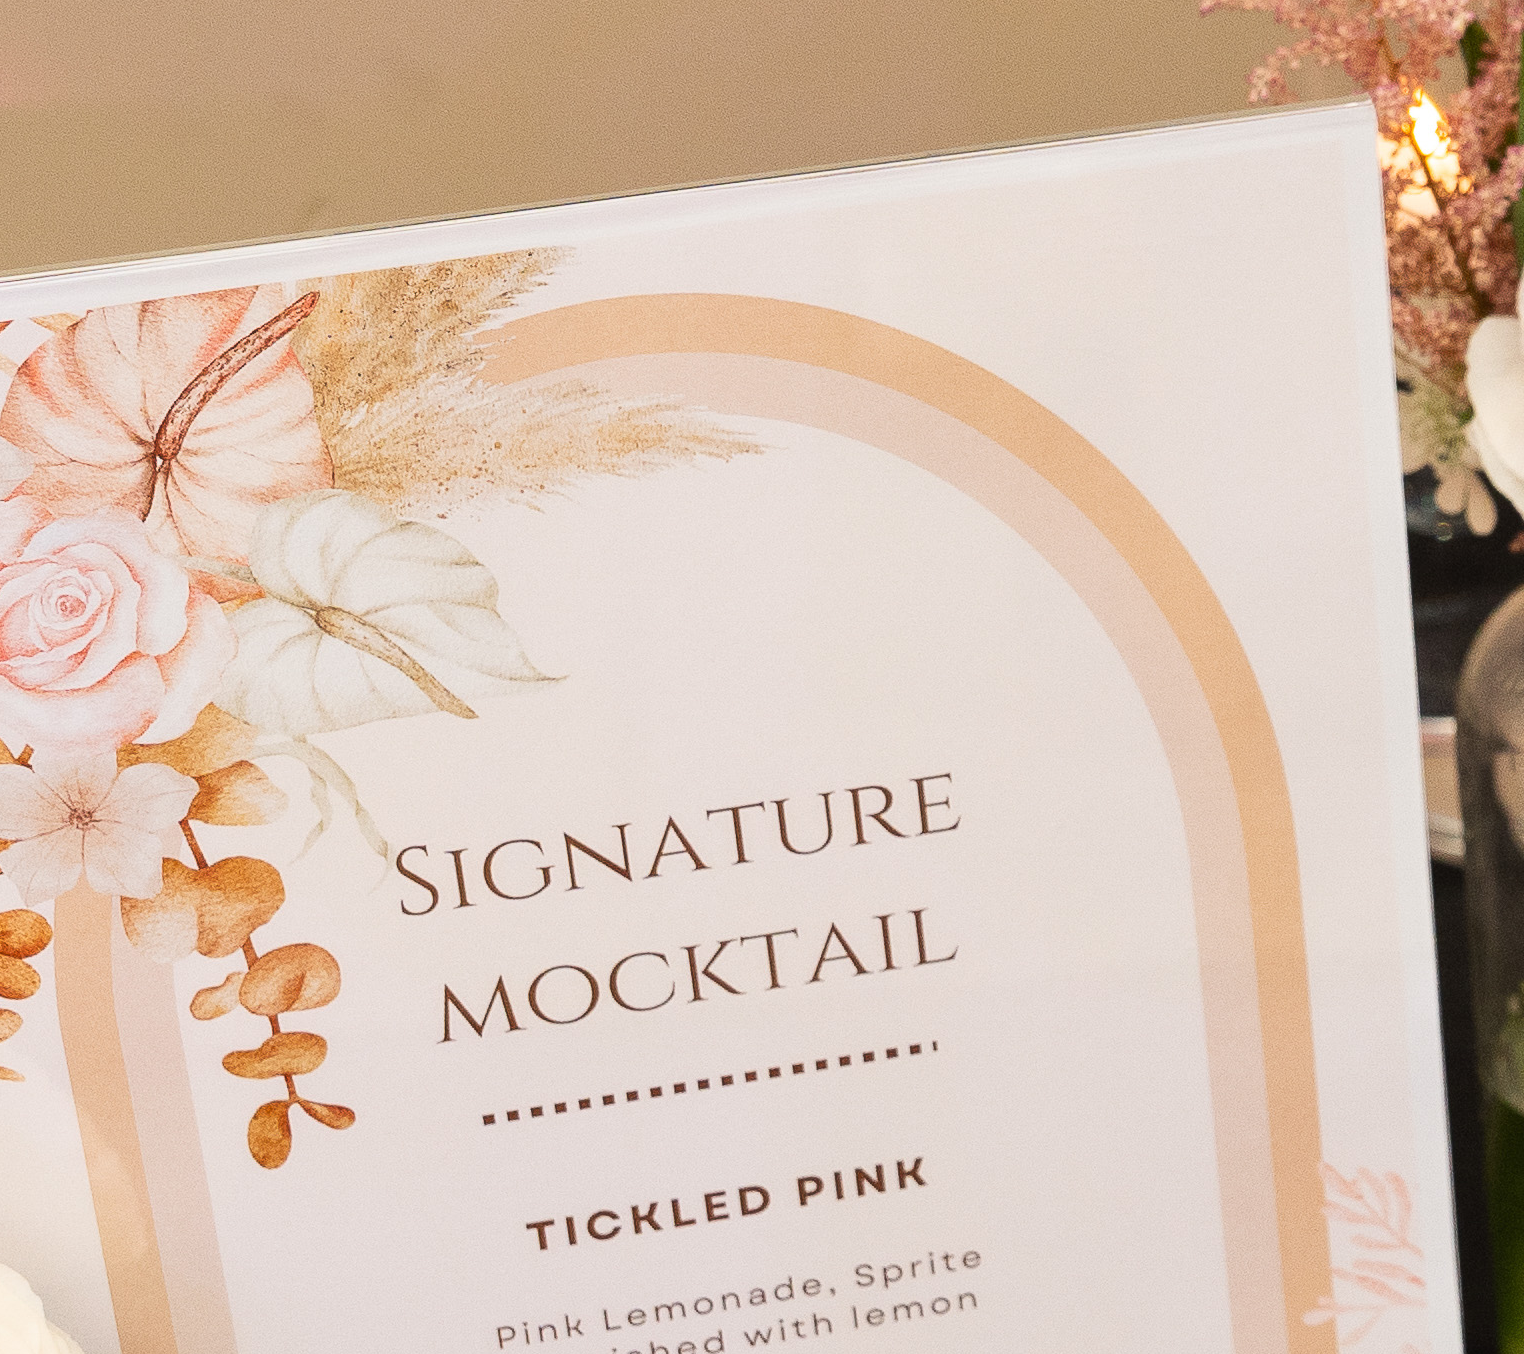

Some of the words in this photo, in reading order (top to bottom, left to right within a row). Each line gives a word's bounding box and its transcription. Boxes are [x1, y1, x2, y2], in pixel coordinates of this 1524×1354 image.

[394, 771, 962, 917] SIGNATURE
[437, 907, 959, 1045] MOCKTAIL
[524, 1184, 772, 1252] TICKLED
[795, 1156, 928, 1208] PINK
[495, 1313, 584, 1350] Pink
[602, 1275, 837, 1332] Lemonade,
[854, 1250, 982, 1290] Sprite
[743, 1312, 833, 1348] with
[851, 1291, 978, 1329] lemon
